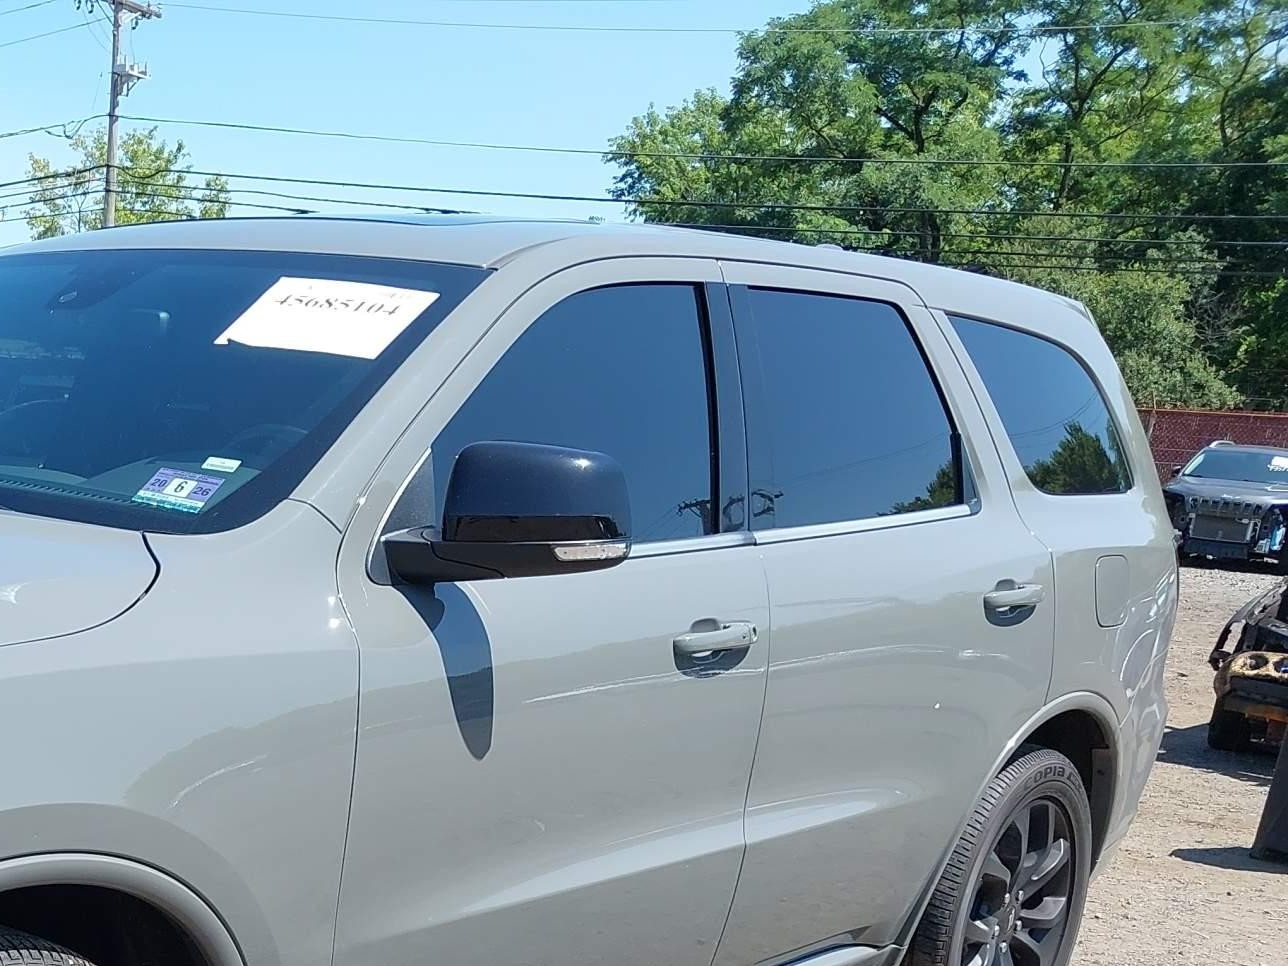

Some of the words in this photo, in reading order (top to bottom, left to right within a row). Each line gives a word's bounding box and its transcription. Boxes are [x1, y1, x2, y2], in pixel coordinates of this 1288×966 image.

[274, 294, 400, 317] 45685104
[150, 478, 168, 488] 20
[174, 480, 187, 493] 6
[192, 486, 211, 497] 26
